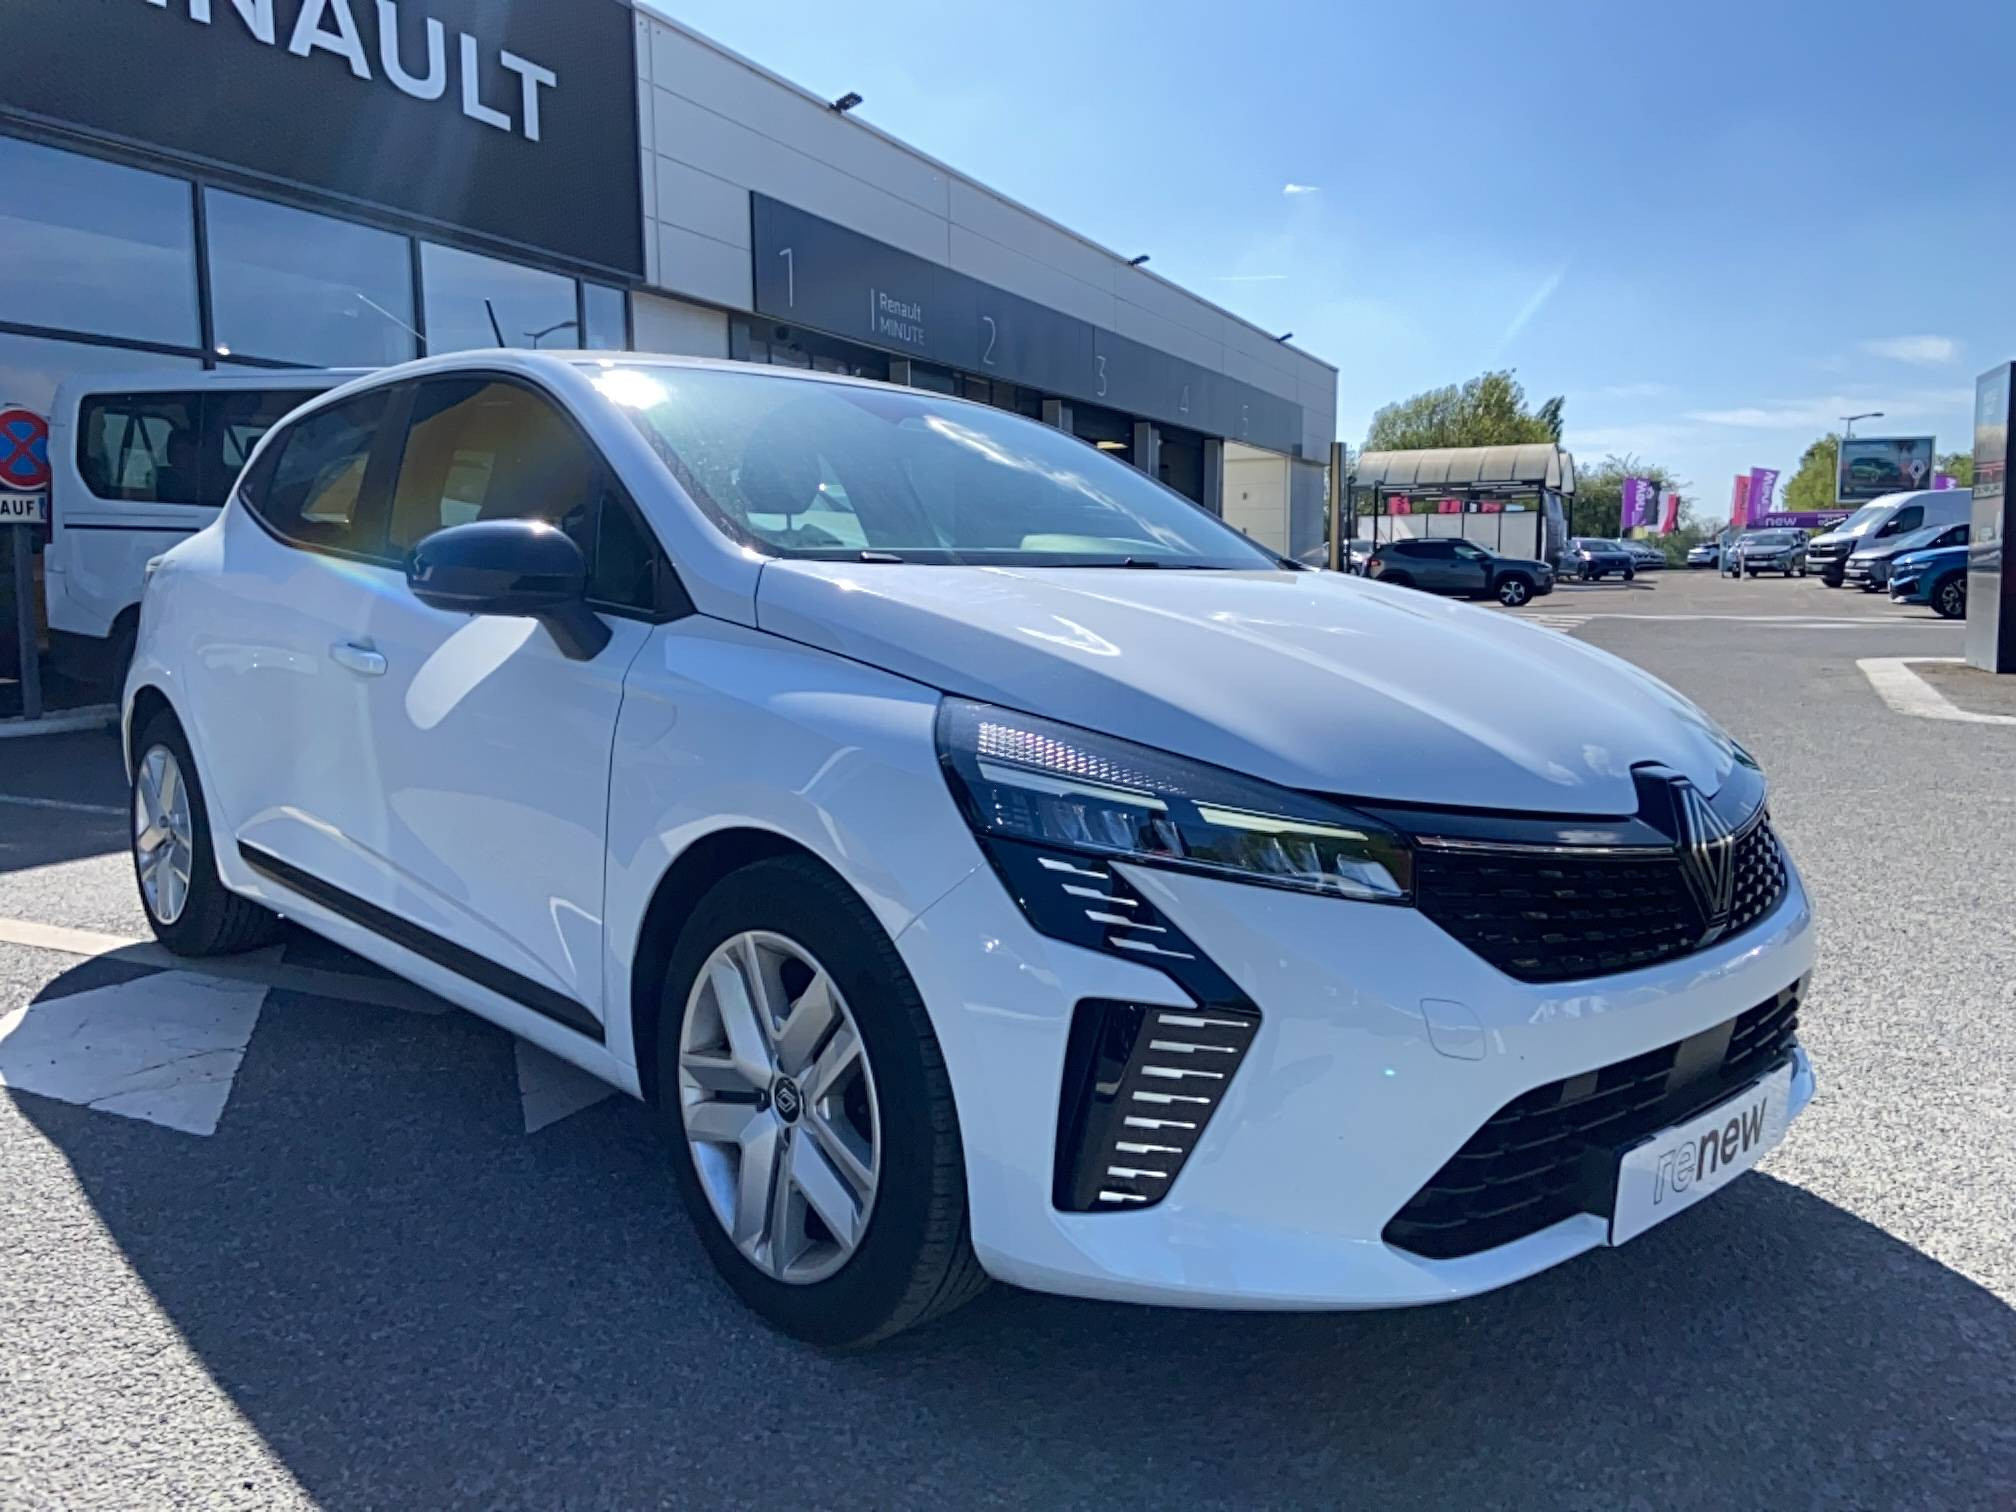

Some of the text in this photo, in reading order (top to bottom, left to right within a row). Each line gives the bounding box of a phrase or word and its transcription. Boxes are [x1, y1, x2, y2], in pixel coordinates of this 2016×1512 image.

[146, 0, 556, 142] AULT
[778, 247, 796, 308] 1
[879, 291, 922, 323] Renault
[880, 317, 925, 346] MINUTE
[981, 315, 997, 366] 2
[1095, 355, 1108, 398] 3
[1179, 385, 1191, 414] 4
[1652, 1096, 1768, 1206] renew
